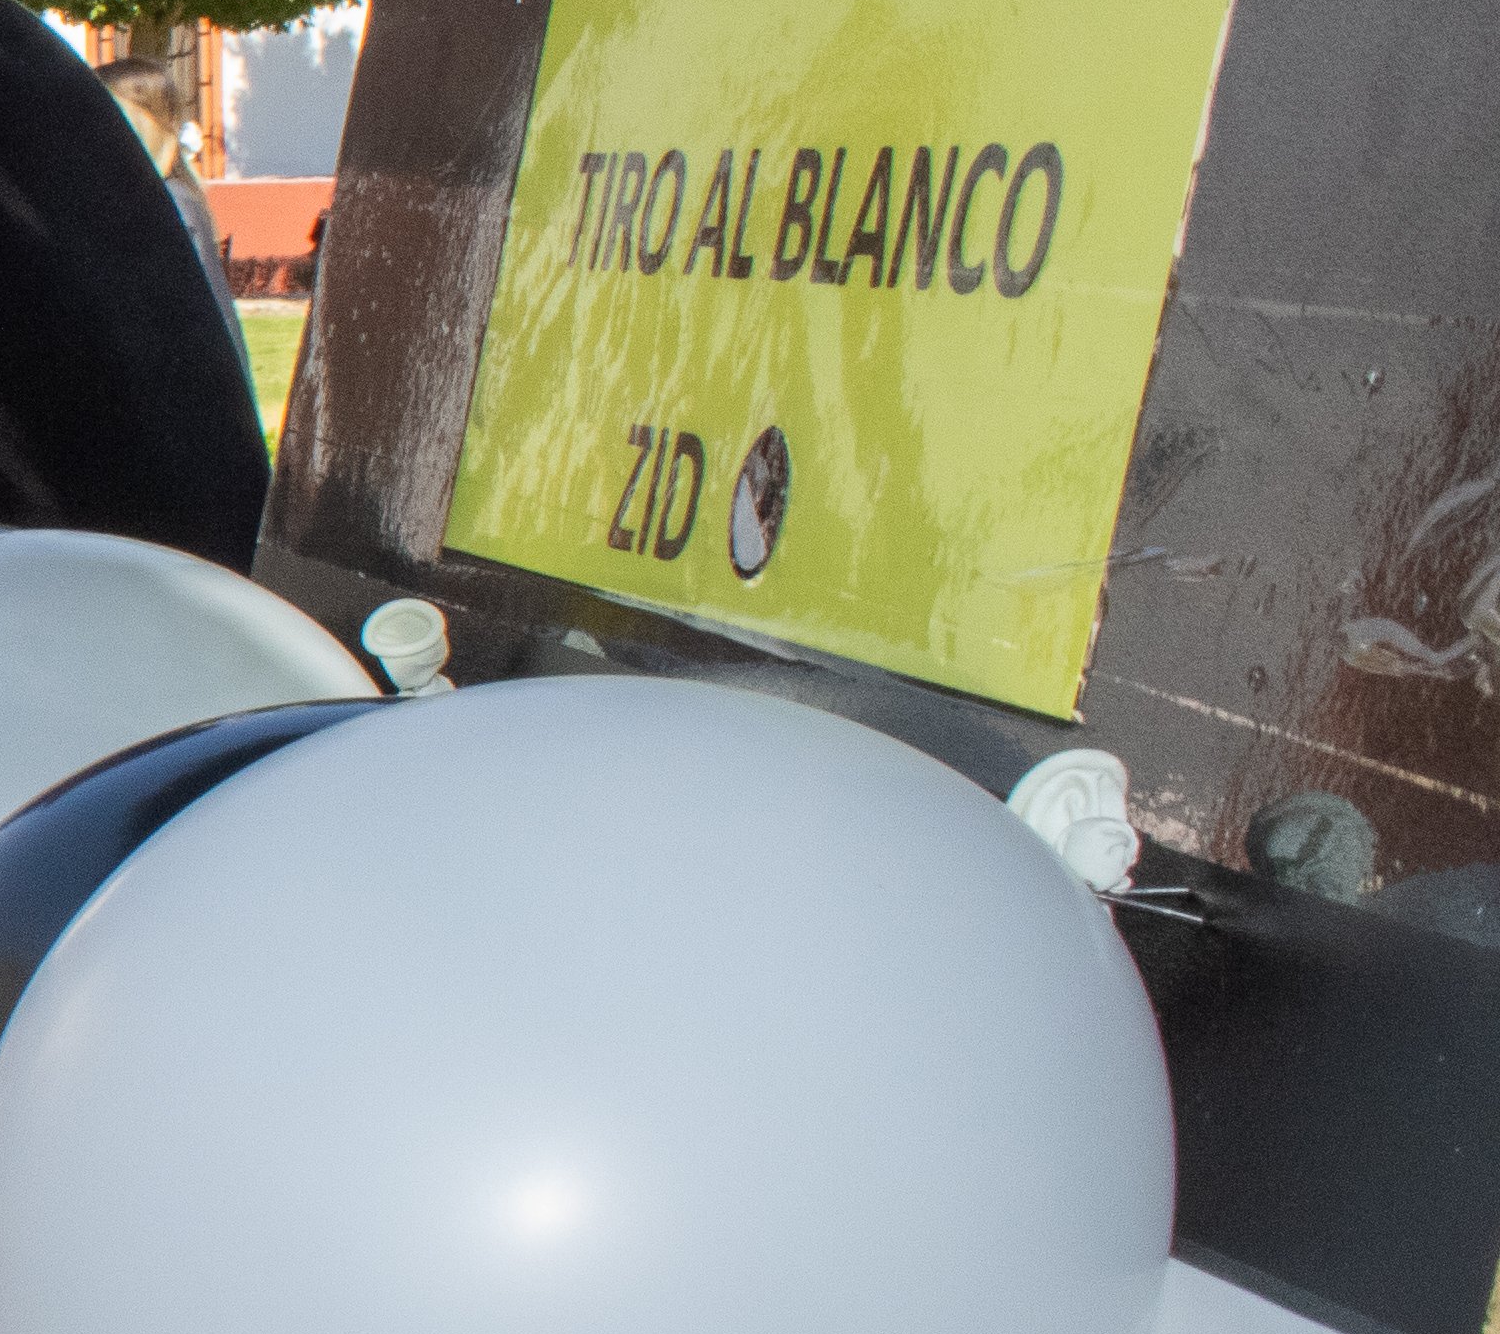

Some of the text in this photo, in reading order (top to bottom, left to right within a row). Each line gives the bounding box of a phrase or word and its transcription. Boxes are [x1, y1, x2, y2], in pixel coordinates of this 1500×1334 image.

[567, 141, 1065, 298] TIRO AL BLANCO
[607, 424, 707, 561] ZID
